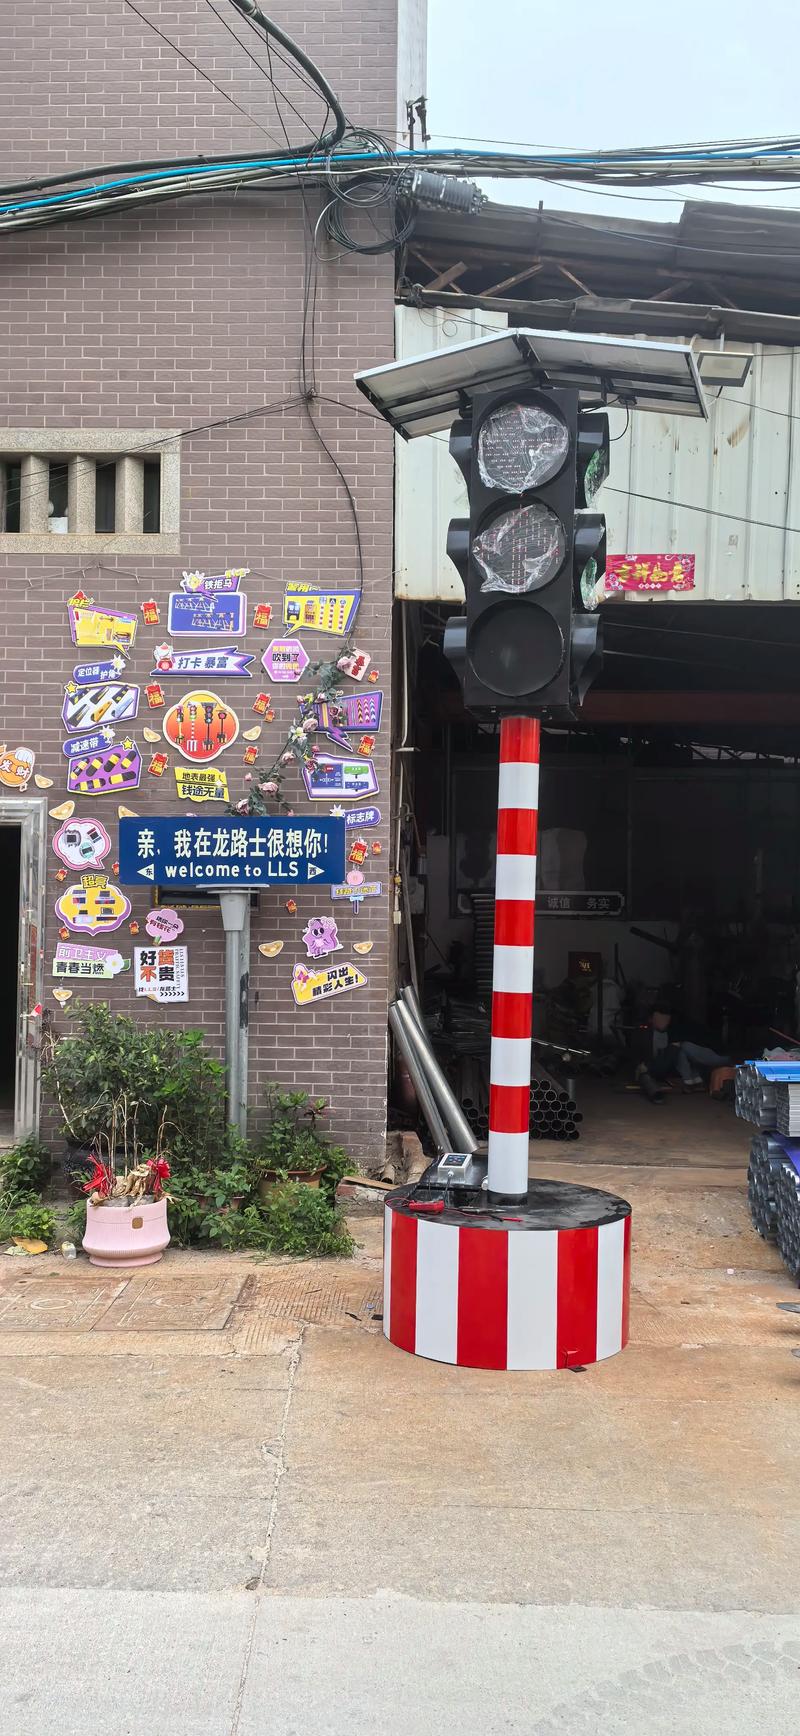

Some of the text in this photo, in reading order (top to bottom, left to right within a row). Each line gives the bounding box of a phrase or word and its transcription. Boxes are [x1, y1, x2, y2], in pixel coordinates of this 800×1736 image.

[177, 656, 229, 669] 打卡 暴富
[272, 653, 300, 662] 吹到了
[70, 736, 99, 753] 减速带
[181, 785, 225, 799] 钱途无量
[346, 810, 375, 825] 标志牌
[145, 867, 154, 877] 东
[165, 861, 299, 878] welcome to LLS
[308, 866, 317, 877] 西
[82, 874, 109, 889] 超亮
[547, 896, 611, 909] 诚信 务实
[56, 961, 105, 975] 青春当燃
[140, 966, 175, 982] 不贵
[327, 967, 349, 981] 闪出
